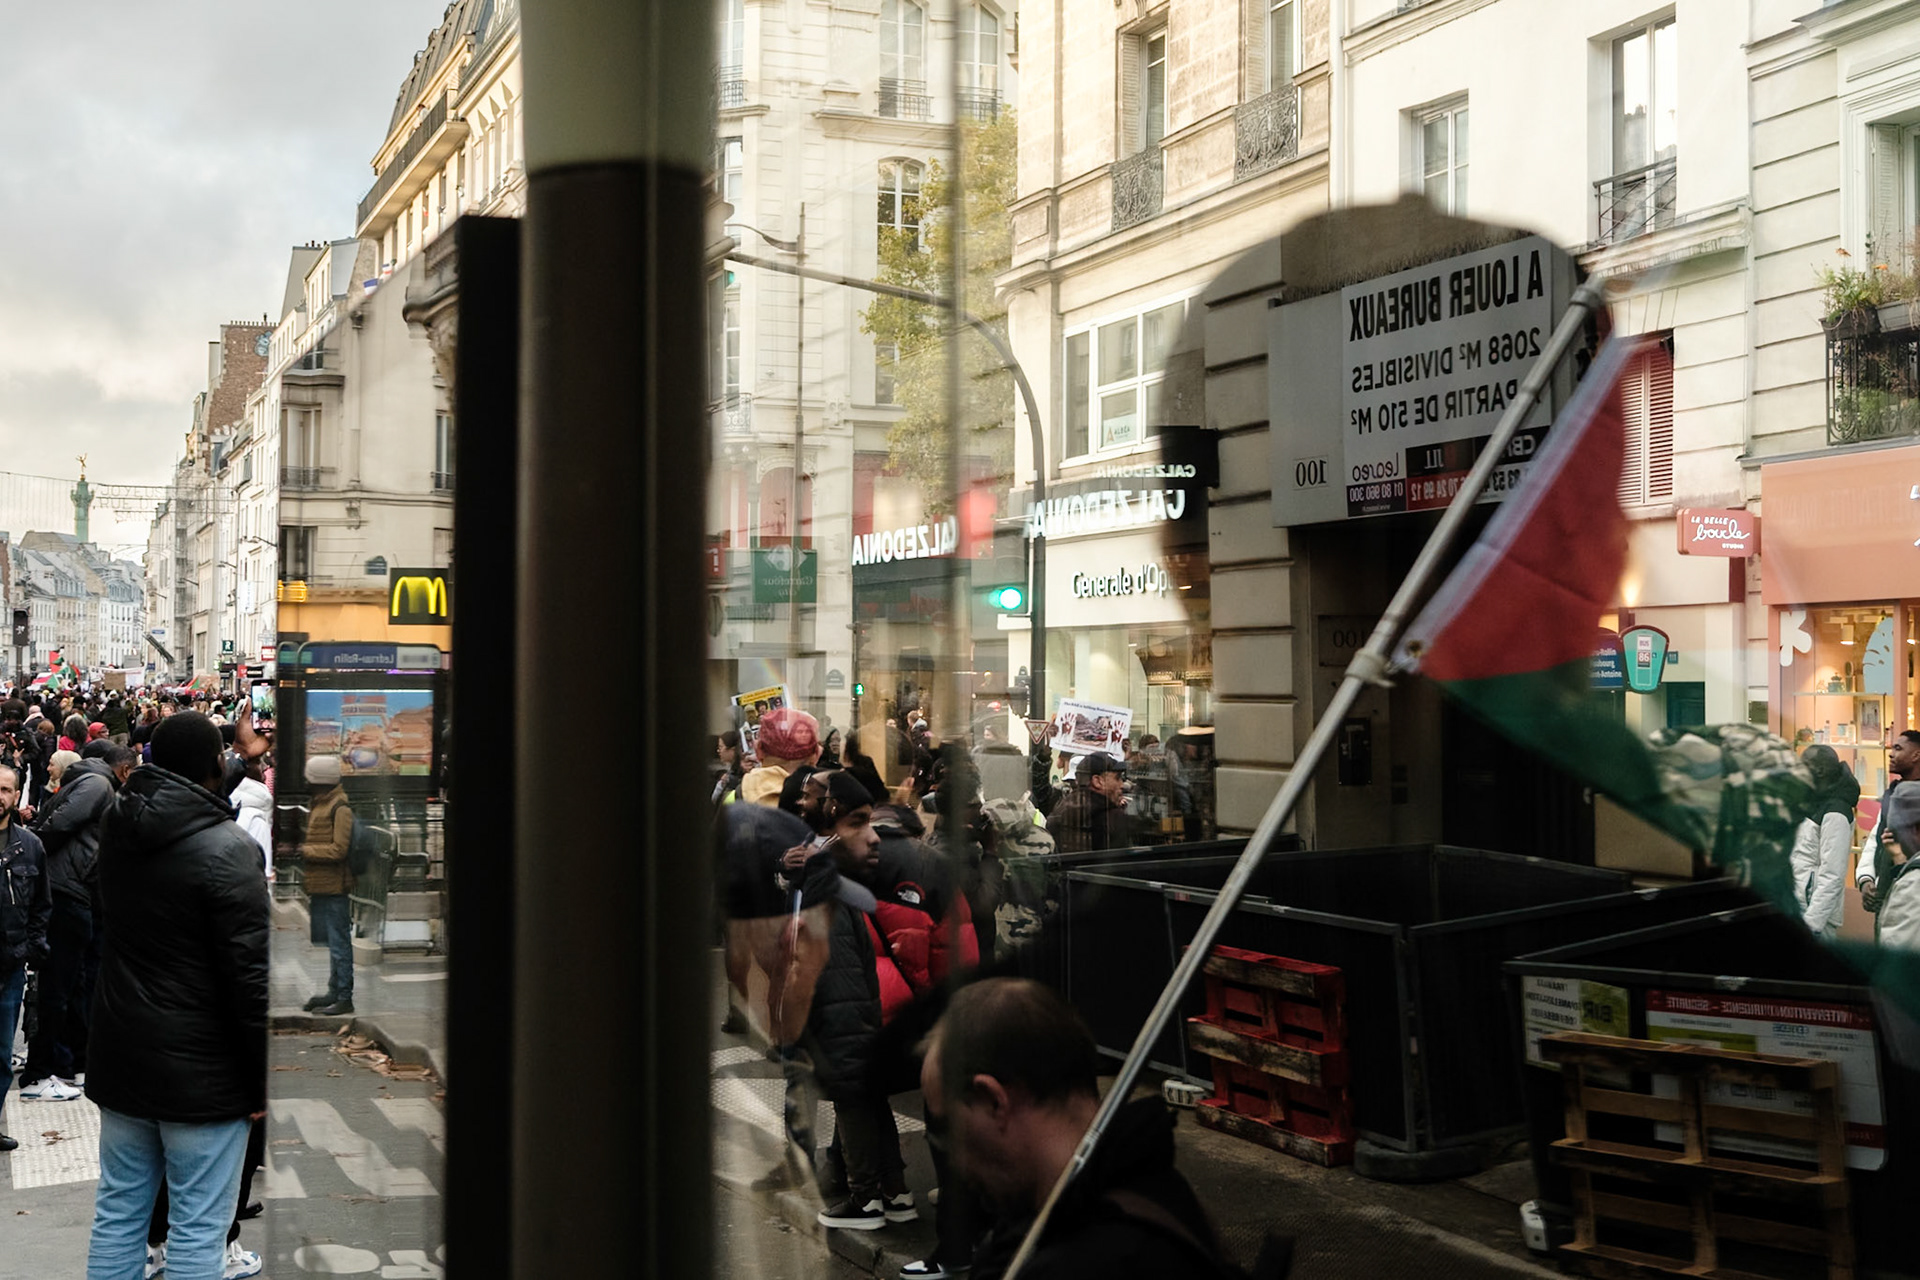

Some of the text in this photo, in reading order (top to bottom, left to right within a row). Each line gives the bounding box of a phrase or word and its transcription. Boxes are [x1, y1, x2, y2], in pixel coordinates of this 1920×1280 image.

[1691, 516, 1729, 525] LA BELLE
[1692, 519, 1751, 542] boucle
[1638, 652, 1650, 662] 86
